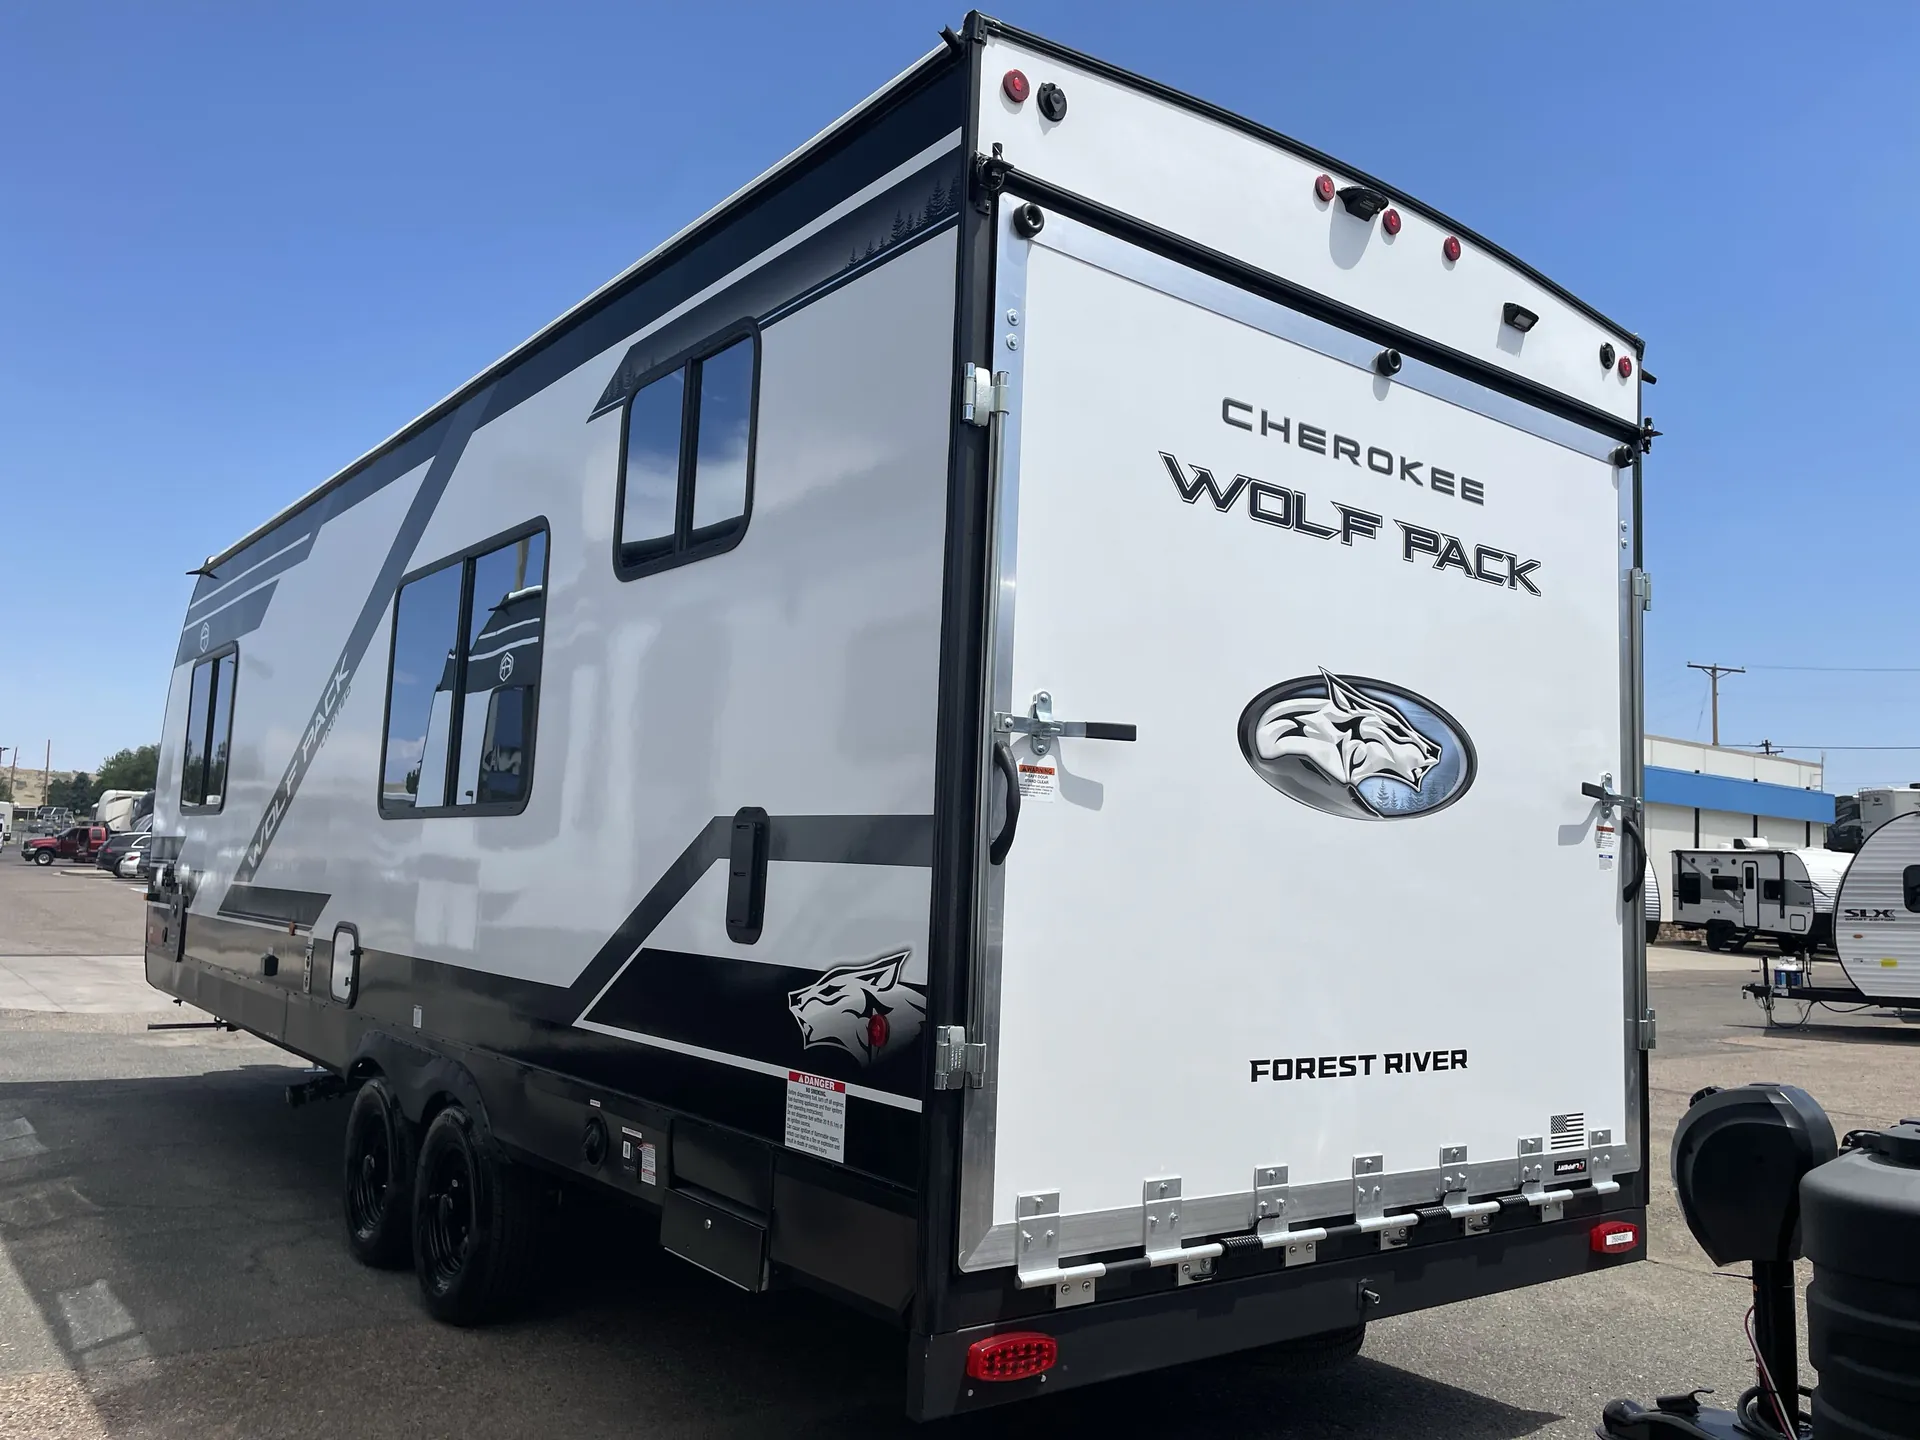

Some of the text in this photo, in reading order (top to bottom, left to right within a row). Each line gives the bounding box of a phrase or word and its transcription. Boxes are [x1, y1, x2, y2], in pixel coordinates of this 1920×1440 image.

[1221, 396, 1485, 506] CHEROKEE
[1158, 450, 1543, 598] WOLF PACK
[247, 652, 350, 869] WOLF PACK
[1844, 909, 1895, 917] SLX
[804, 1076, 835, 1090] DANGER
[1249, 1049, 1468, 1083] FOREST RIVER
